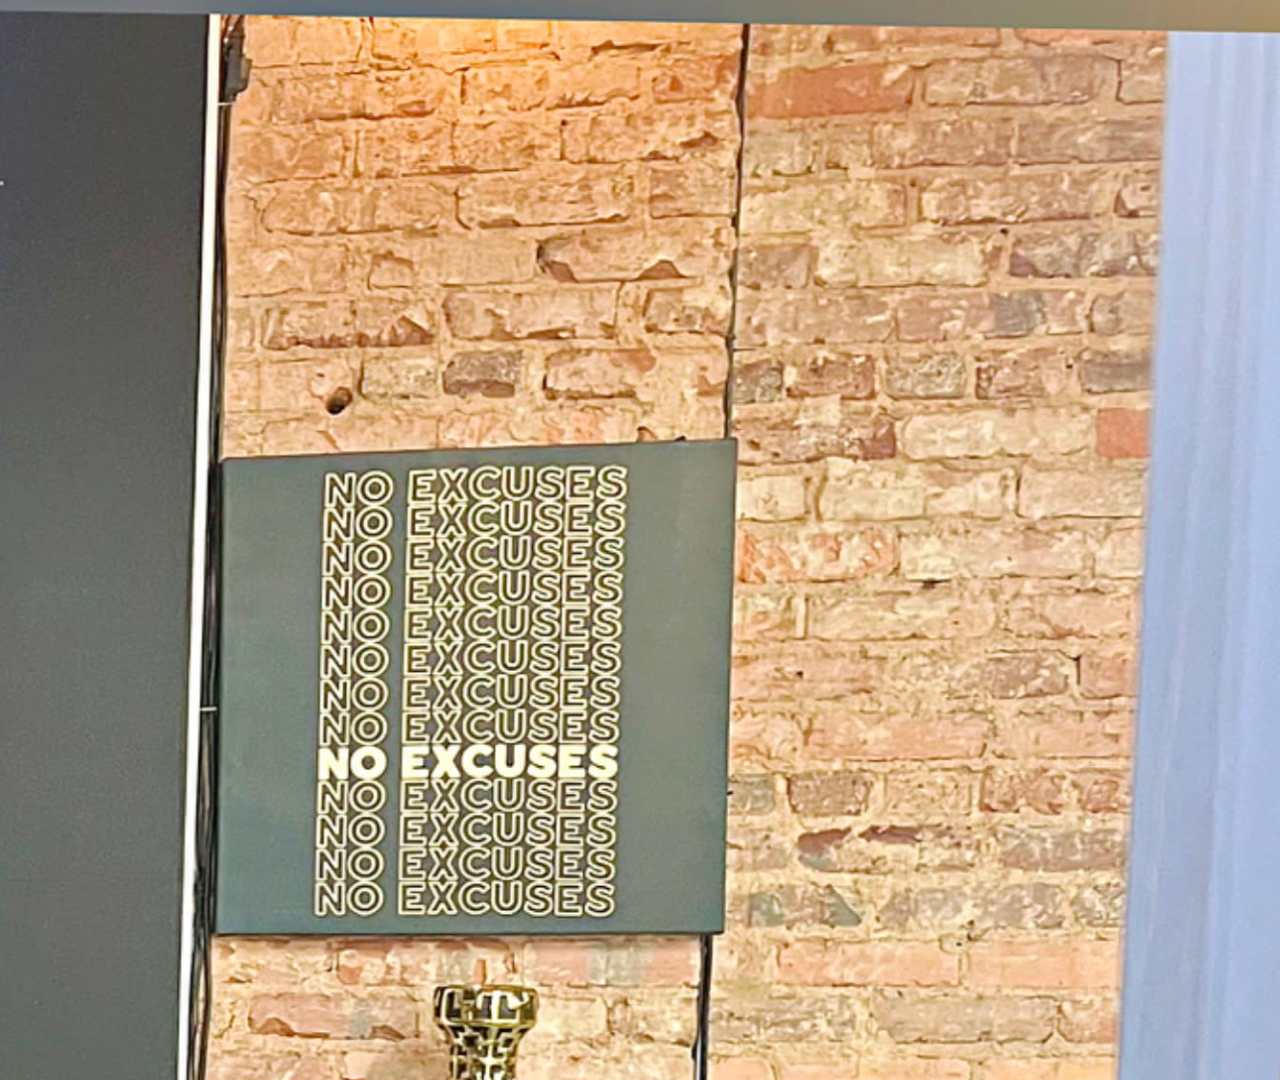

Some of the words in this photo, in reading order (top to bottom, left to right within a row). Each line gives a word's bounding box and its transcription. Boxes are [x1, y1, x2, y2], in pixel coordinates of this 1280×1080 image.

[325, 472, 392, 507] NO
[409, 466, 627, 502] EXCUSES
[324, 507, 391, 542] NO
[407, 501, 625, 537] EXCUSES
[324, 542, 390, 577] NO
[407, 536, 624, 572] EXCUSES
[323, 577, 390, 612] NO
[407, 572, 623, 606] EXCUSES
[322, 612, 389, 645] NO
[405, 607, 621, 641] EXCUSES
[321, 645, 388, 679] NO
[405, 642, 620, 675] EXCUSES
[321, 679, 387, 712] NO
[404, 676, 619, 709] EXCUSES
[319, 713, 387, 745] NO
[403, 710, 618, 743] EXCUSES
[318, 747, 386, 779] NO
[402, 745, 617, 779] EXCUSES
[318, 781, 384, 814] NO
[401, 780, 616, 813] EXCUSES
[317, 815, 384, 848] NO
[400, 814, 616, 848] EXCUSES
[316, 849, 383, 882] NO
[399, 848, 614, 881] EXCUSES
[316, 882, 382, 915] NO
[399, 882, 614, 916] EXCUSES
